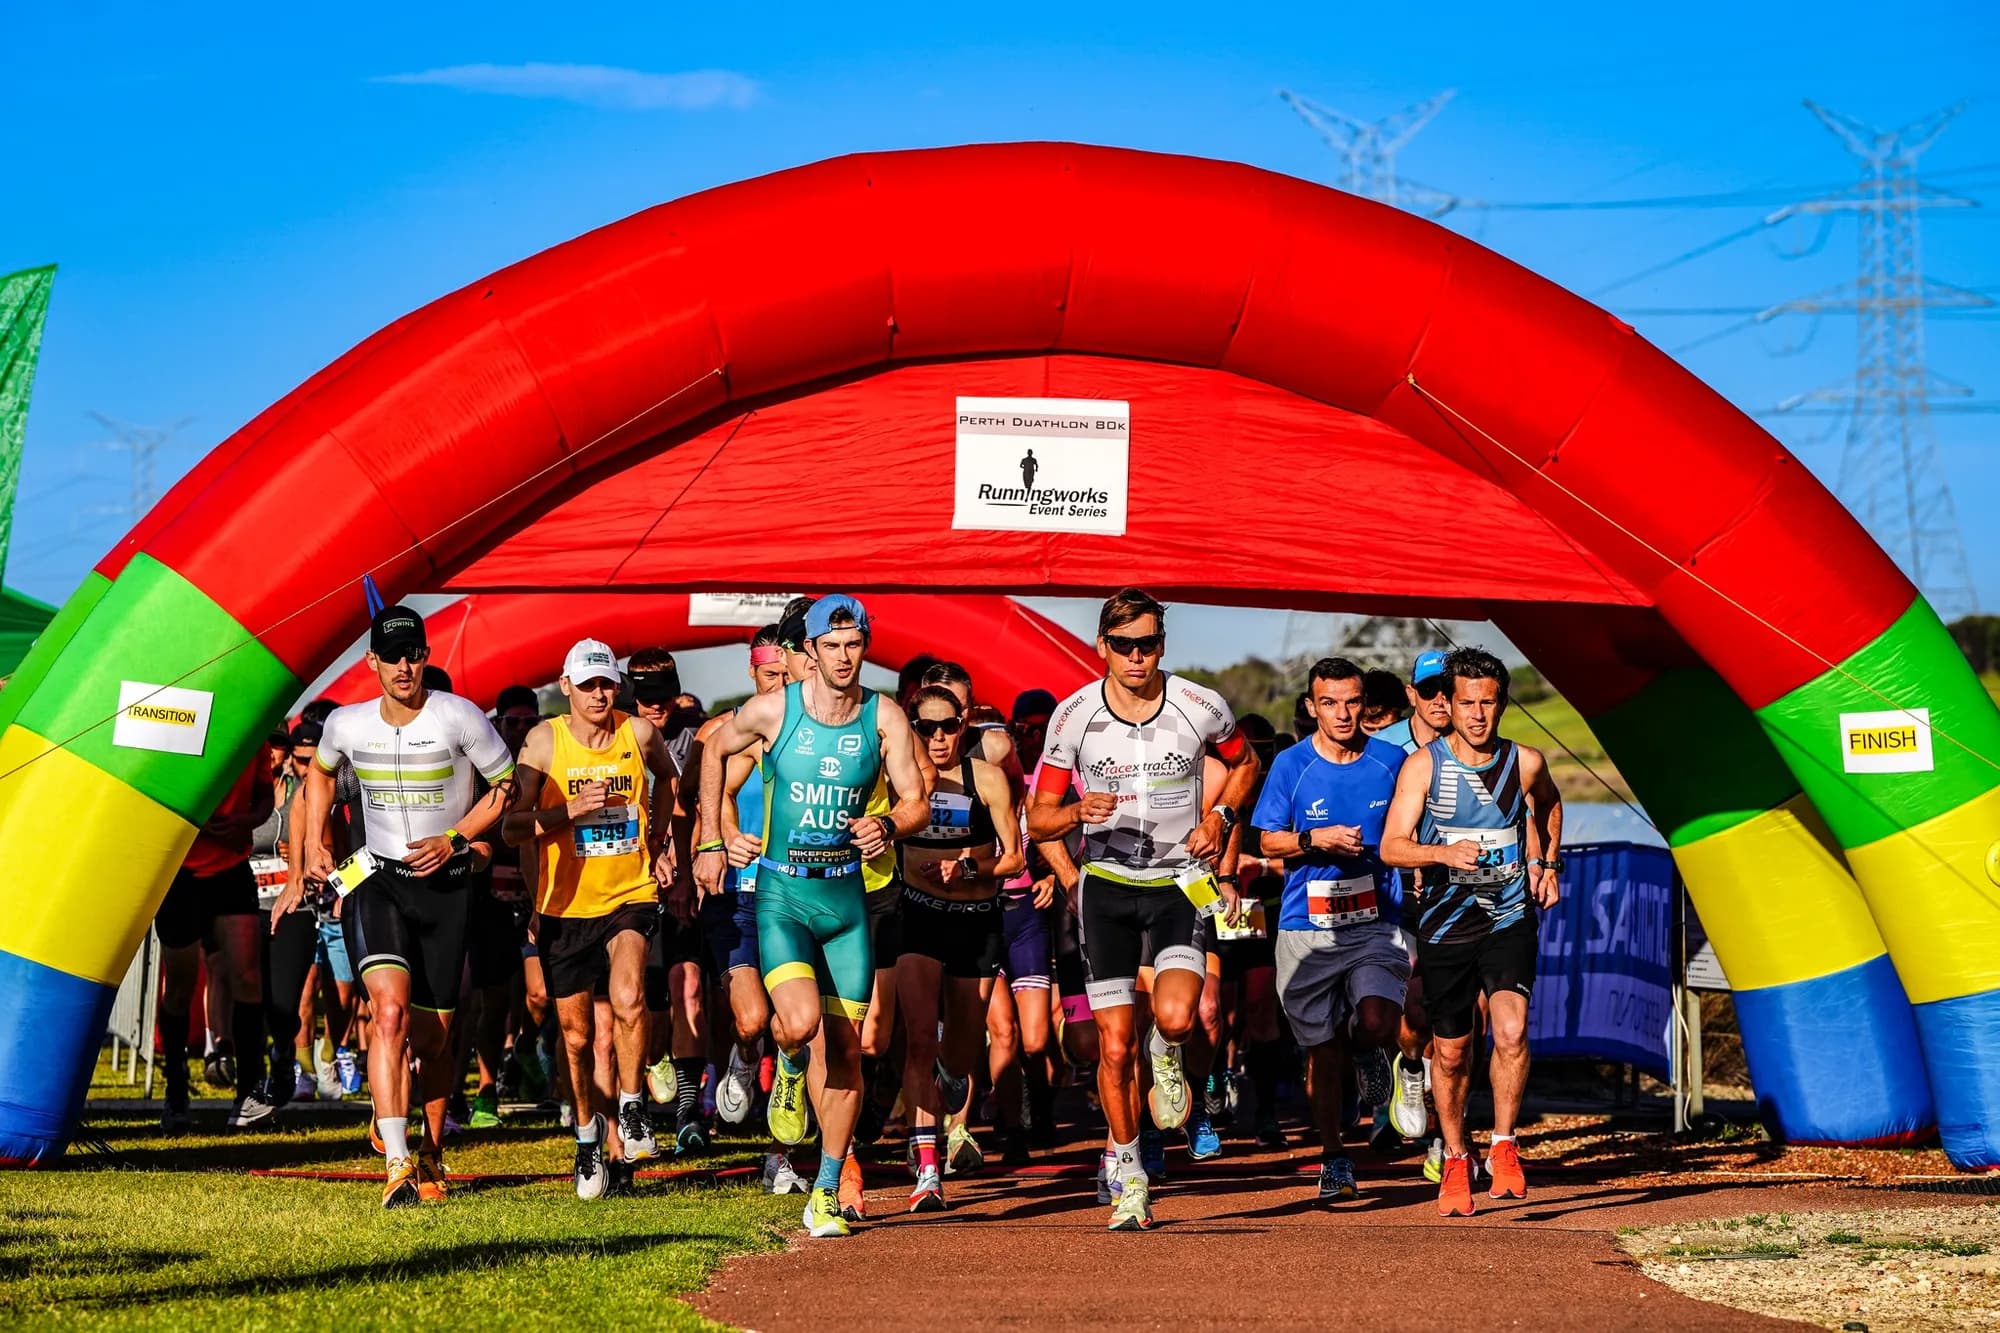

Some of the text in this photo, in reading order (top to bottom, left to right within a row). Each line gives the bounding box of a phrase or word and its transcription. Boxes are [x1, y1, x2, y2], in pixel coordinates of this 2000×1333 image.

[977, 483, 1109, 505] Runningworks
[1029, 504, 1108, 518] Event Series
[127, 704, 197, 724] TRANSITION
[1849, 729, 1917, 750] FINISH
[567, 764, 618, 778] income
[789, 781, 863, 807] SMITH
[798, 807, 849, 830] AUS
[591, 823, 628, 842] 549
[903, 887, 946, 911] NIKE
[946, 902, 992, 913] PRO
